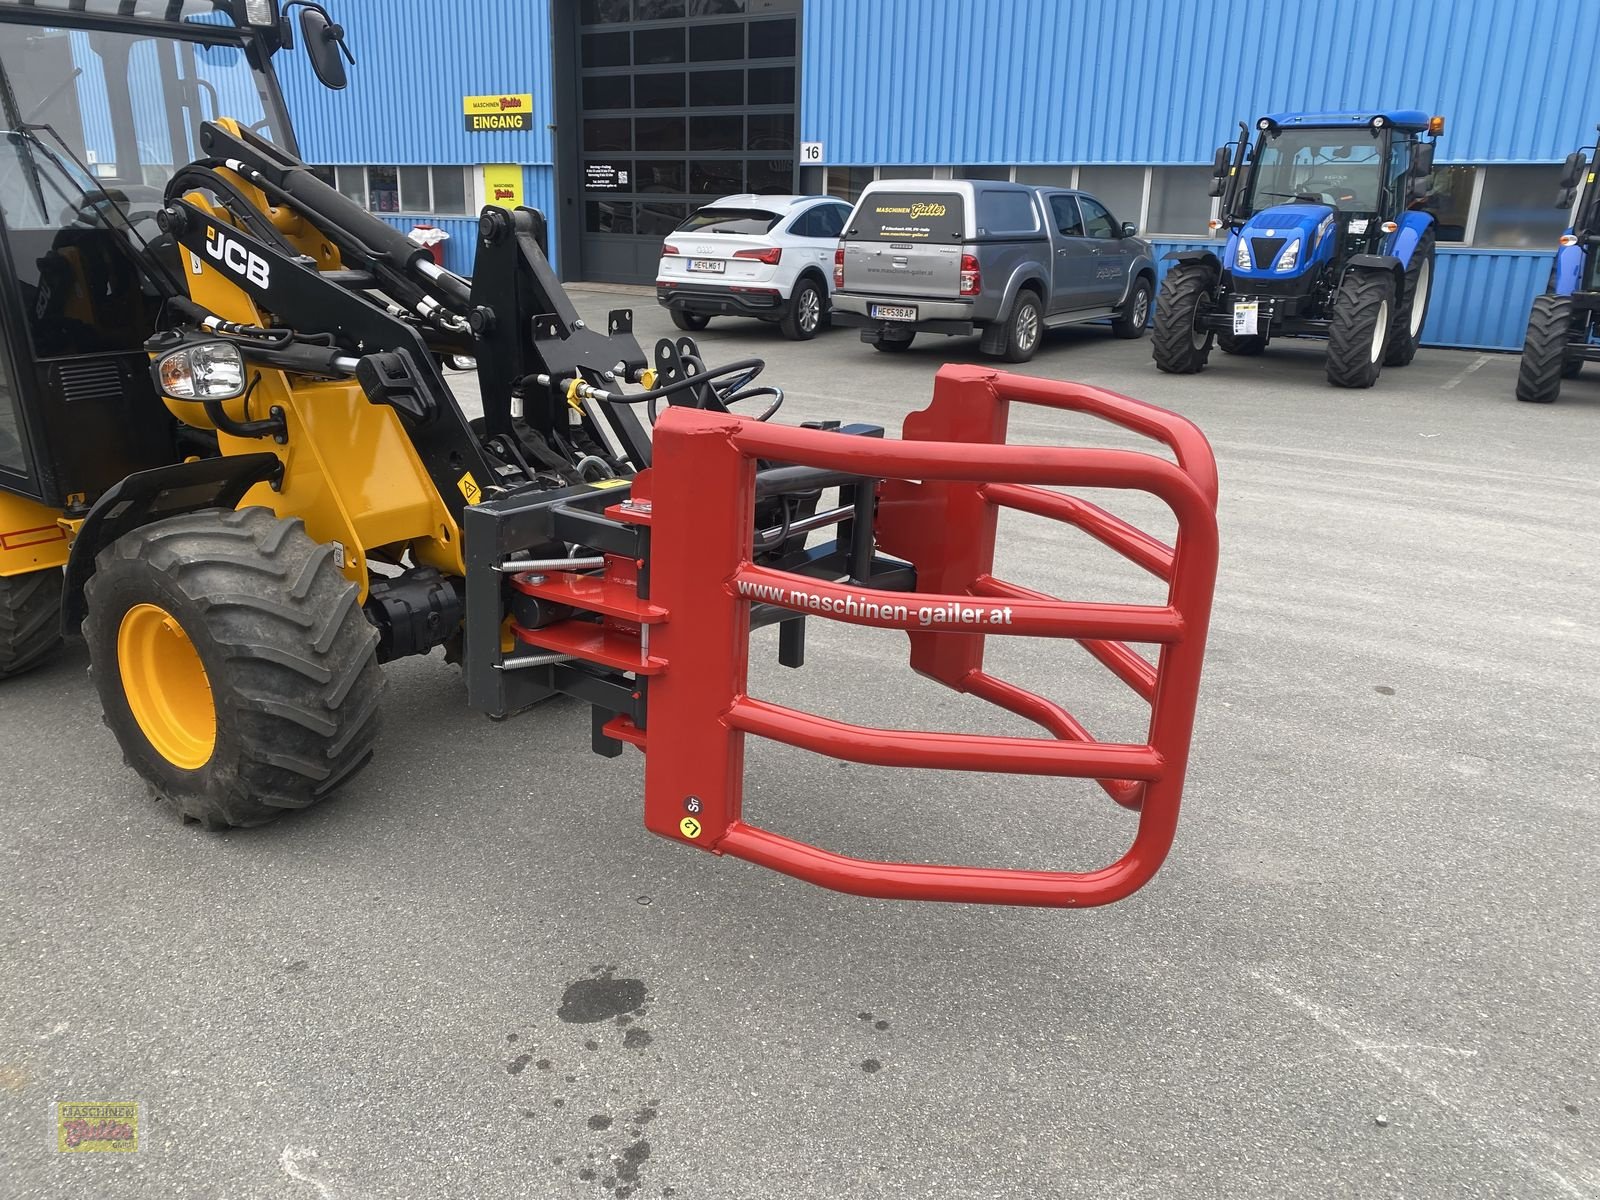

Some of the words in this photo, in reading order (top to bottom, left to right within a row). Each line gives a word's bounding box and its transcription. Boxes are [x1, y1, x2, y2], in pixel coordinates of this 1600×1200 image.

[473, 115, 523, 129] EINGANG
[806, 146, 819, 159] 16
[910, 203, 946, 220] Gailer
[206, 231, 270, 290] JCB
[877, 307, 887, 316] HE
[737, 580, 1012, 626] www.maschinen-gailer.at
